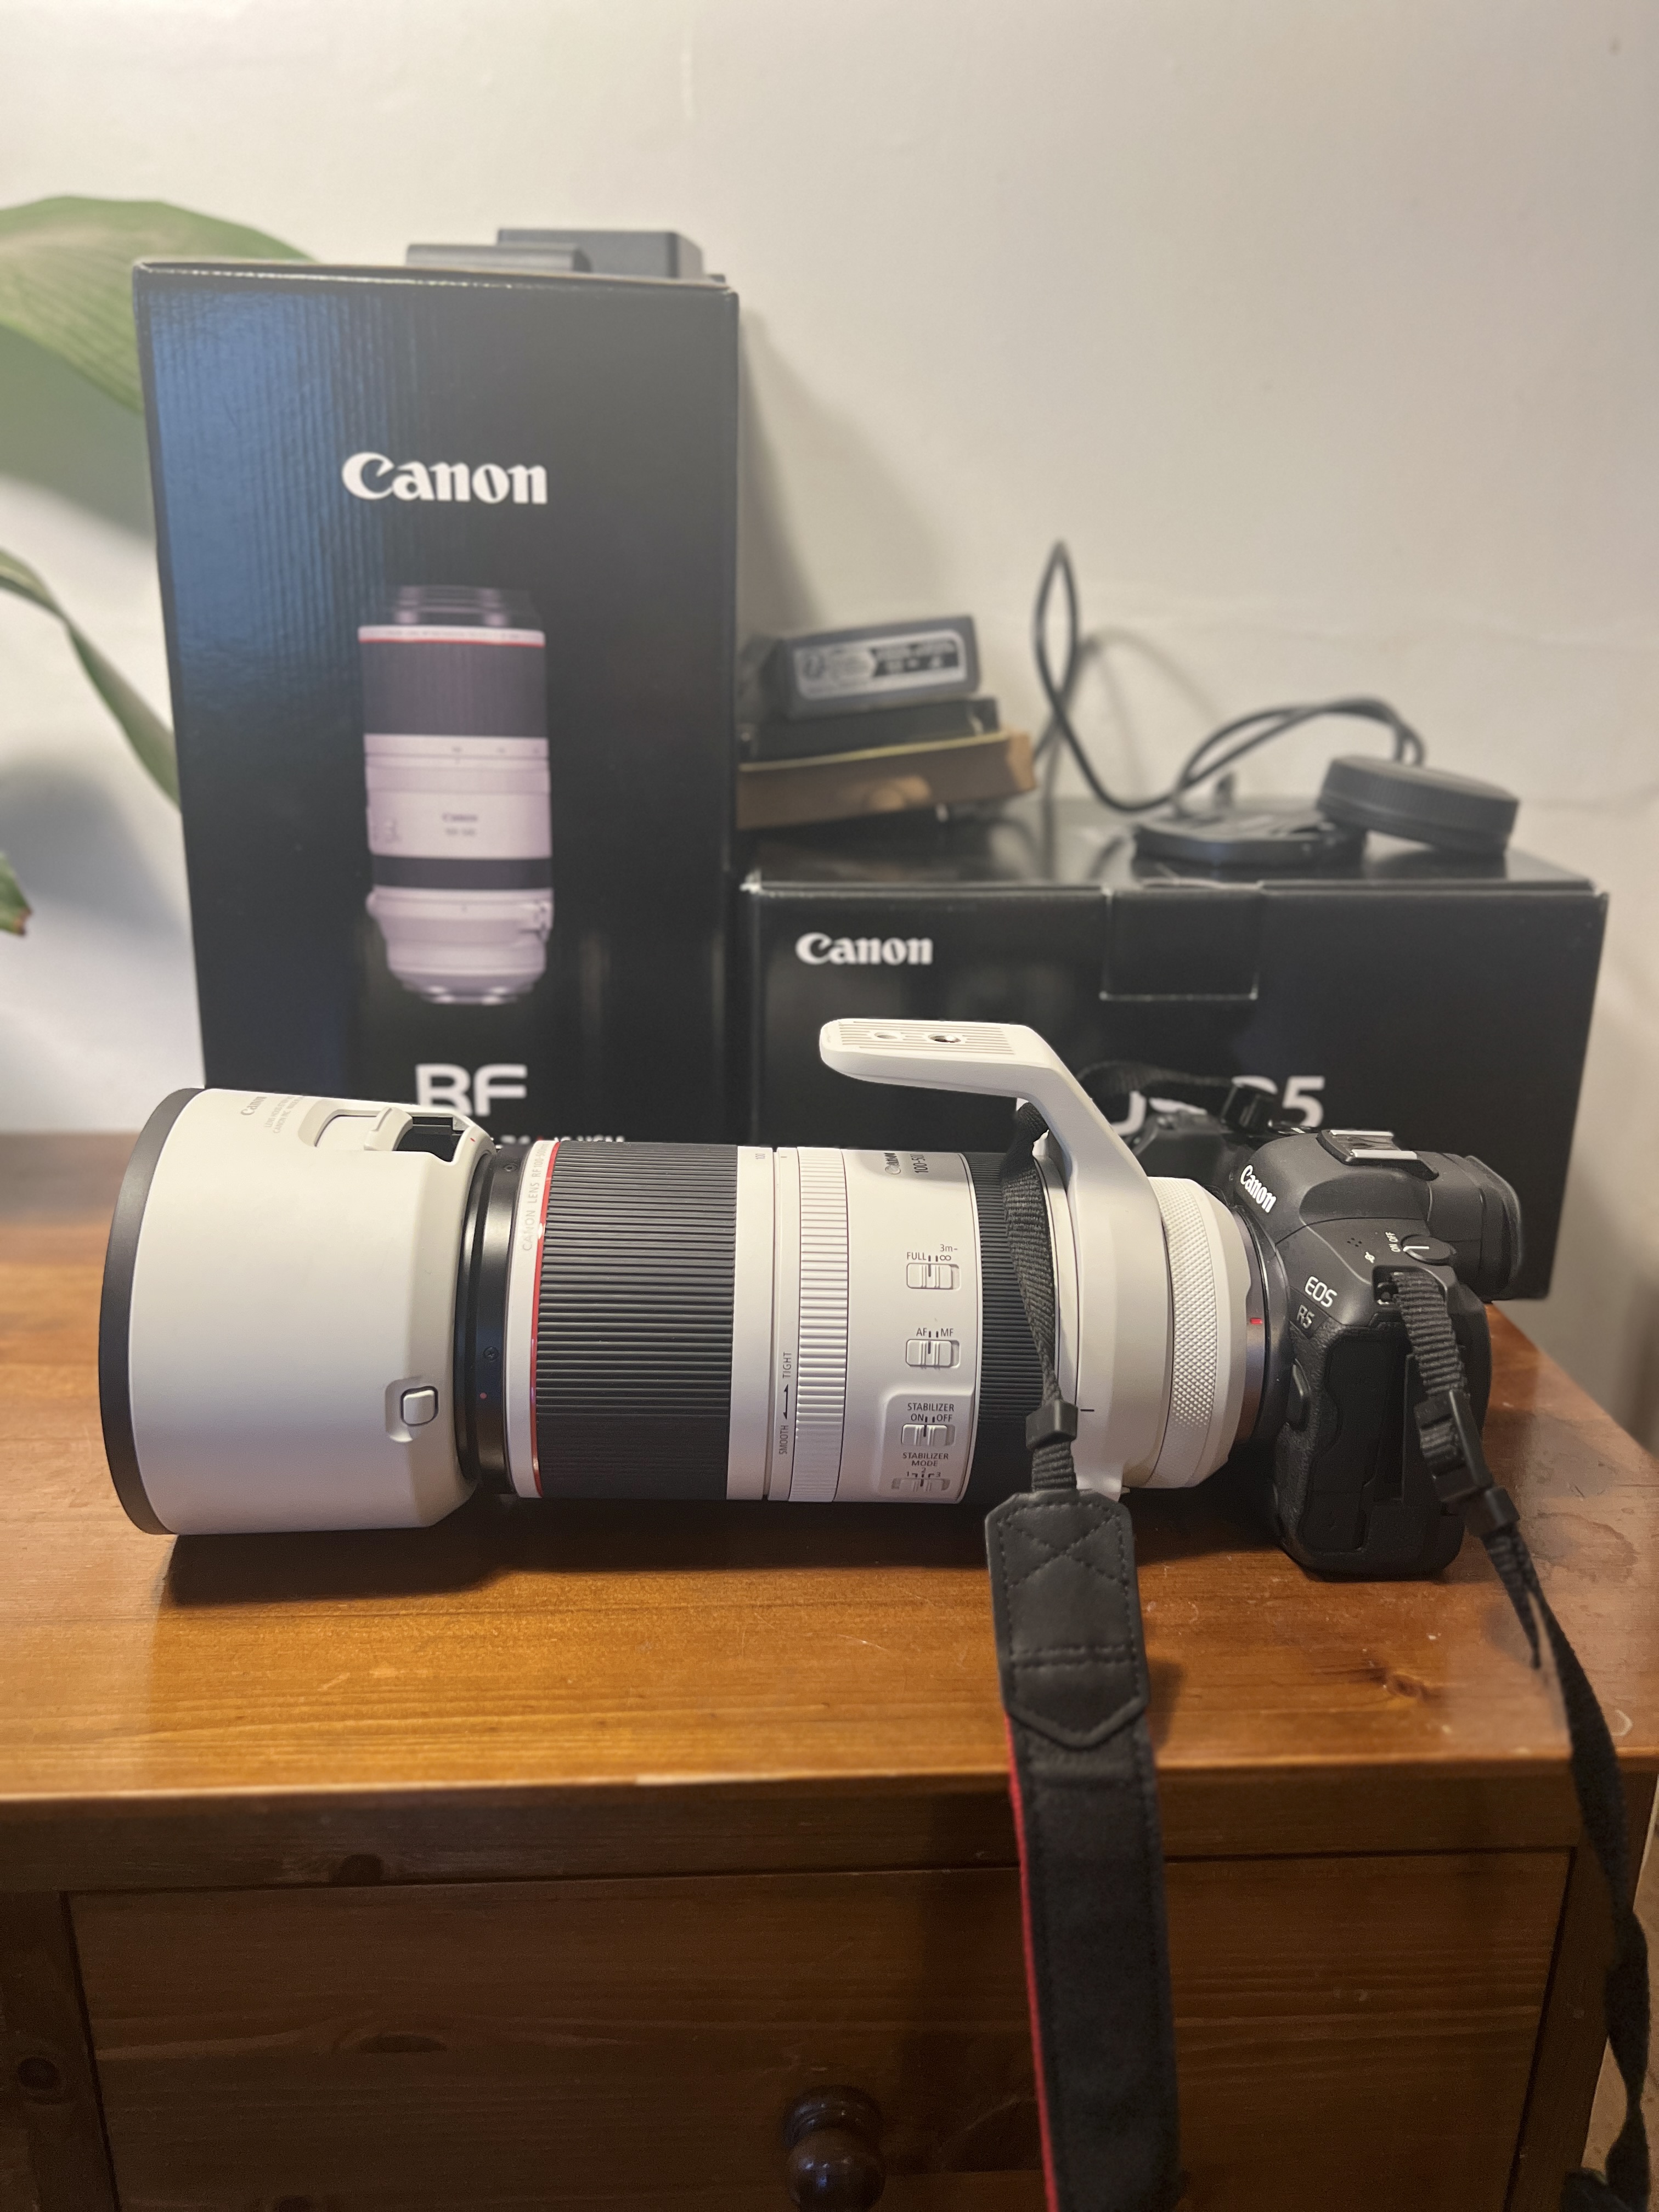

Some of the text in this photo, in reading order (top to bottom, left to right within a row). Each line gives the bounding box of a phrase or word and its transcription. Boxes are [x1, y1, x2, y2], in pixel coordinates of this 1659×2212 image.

[342, 452, 547, 504] Canon
[795, 932, 933, 965] Canon
[415, 1064, 527, 1117] RF
[240, 1096, 267, 1115] Canon
[527, 1182, 540, 1204] LENS
[1240, 1165, 1277, 1213] Canon
[523, 1210, 535, 1251] CANON
[1385, 1232, 1401, 1252] ON OFF
[907, 1251, 927, 1261] FULL
[1305, 1276, 1338, 1307] EOS
[1296, 1305, 1315, 1329] R5
[916, 1327, 953, 1337] AF MF
[778, 1352, 792, 1454] SMOOTH TIGHT
[907, 1402, 955, 1412] STABILIZER
[911, 1413, 953, 1422] ON OFF
